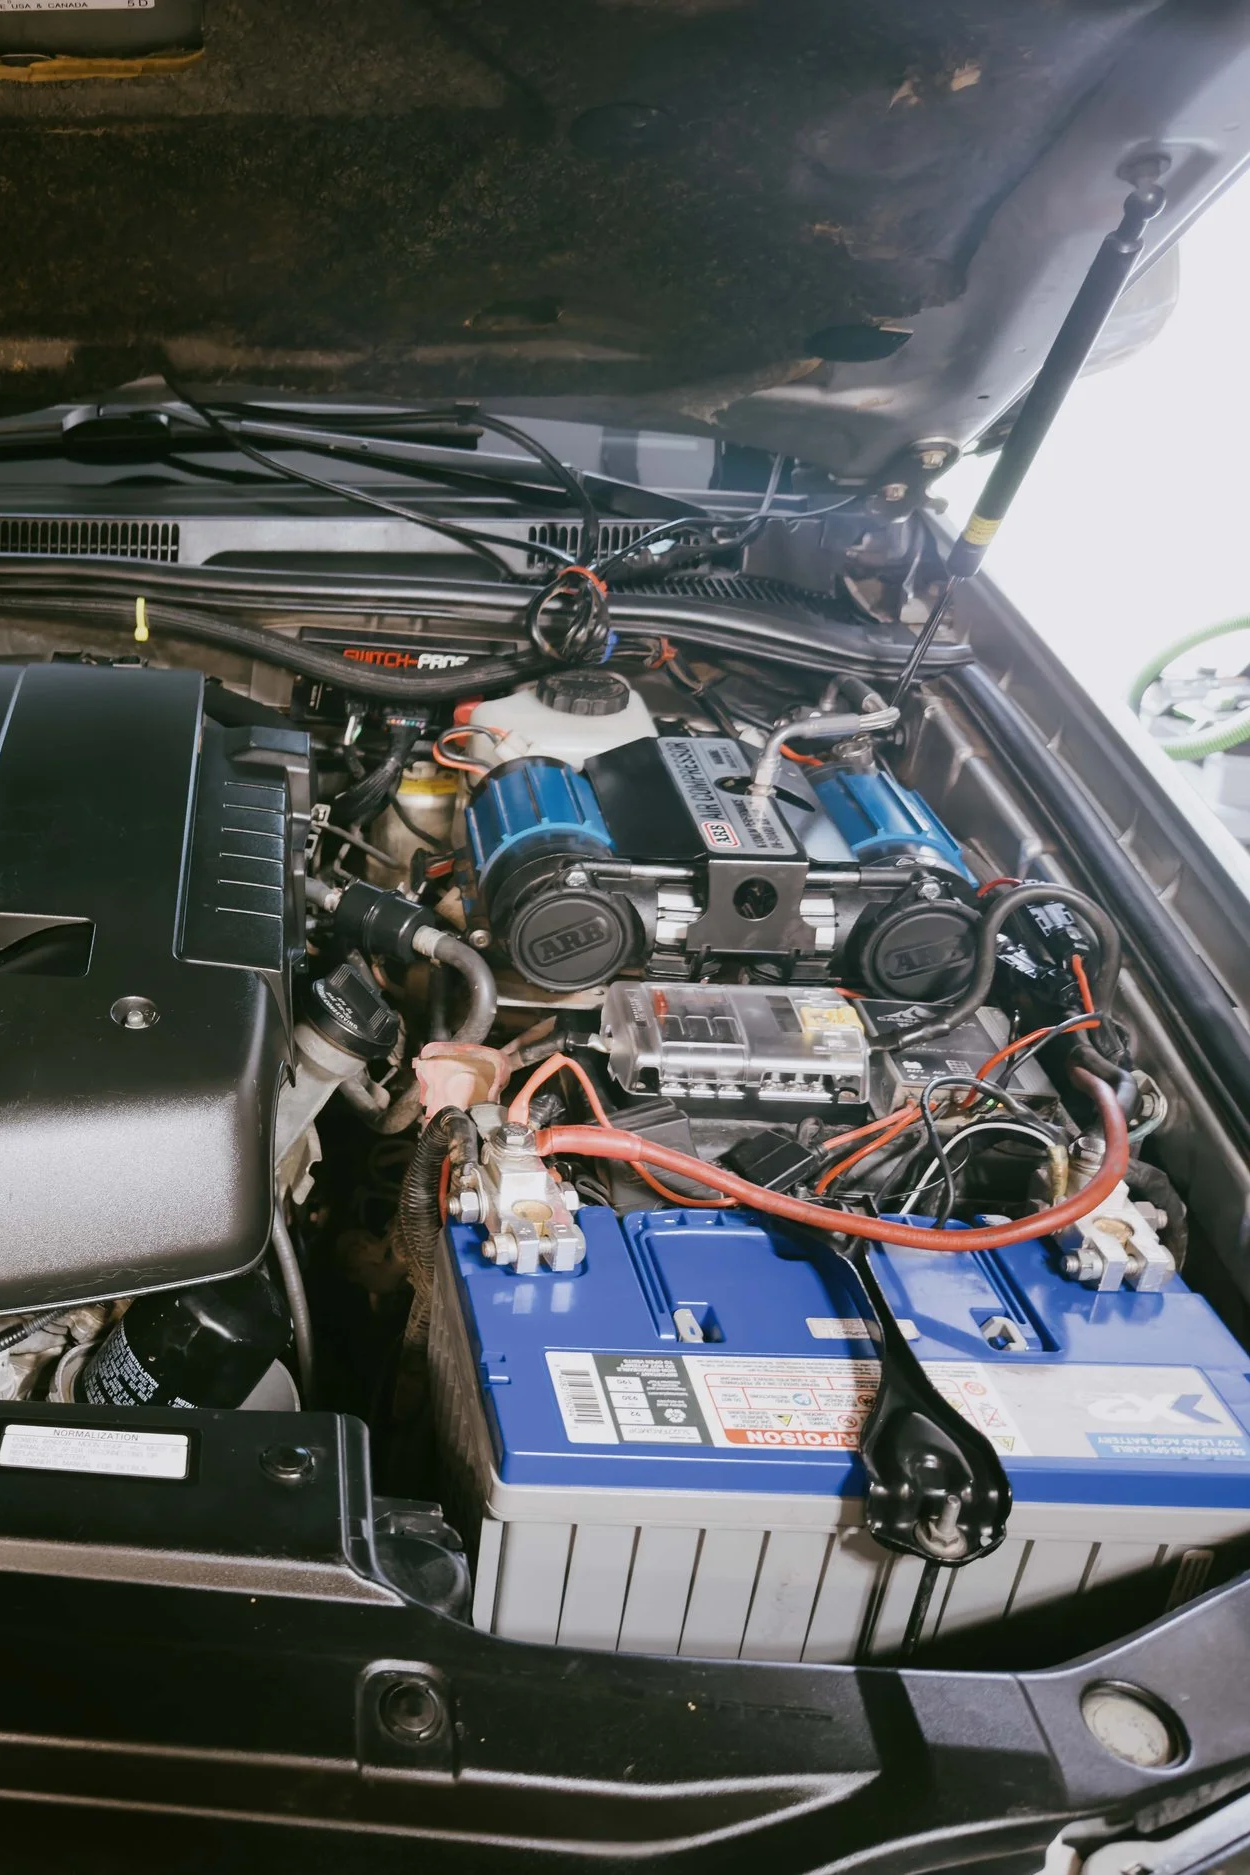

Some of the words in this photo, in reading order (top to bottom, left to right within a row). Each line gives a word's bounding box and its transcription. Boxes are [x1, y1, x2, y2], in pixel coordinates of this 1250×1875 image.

[665, 742, 714, 801] COMPRESSOR
[695, 804, 725, 820] AIR
[709, 824, 732, 844] ARB
[540, 921, 605, 961] ARB
[323, 999, 358, 1030] CONSERVING
[53, 1429, 139, 1441] NORMALIZATION
[746, 1431, 858, 1446] R/POISON
[1098, 1436, 1149, 1445] BATTERY
[1151, 1438, 1179, 1446] ACID
[1182, 1439, 1214, 1447] LEAD
